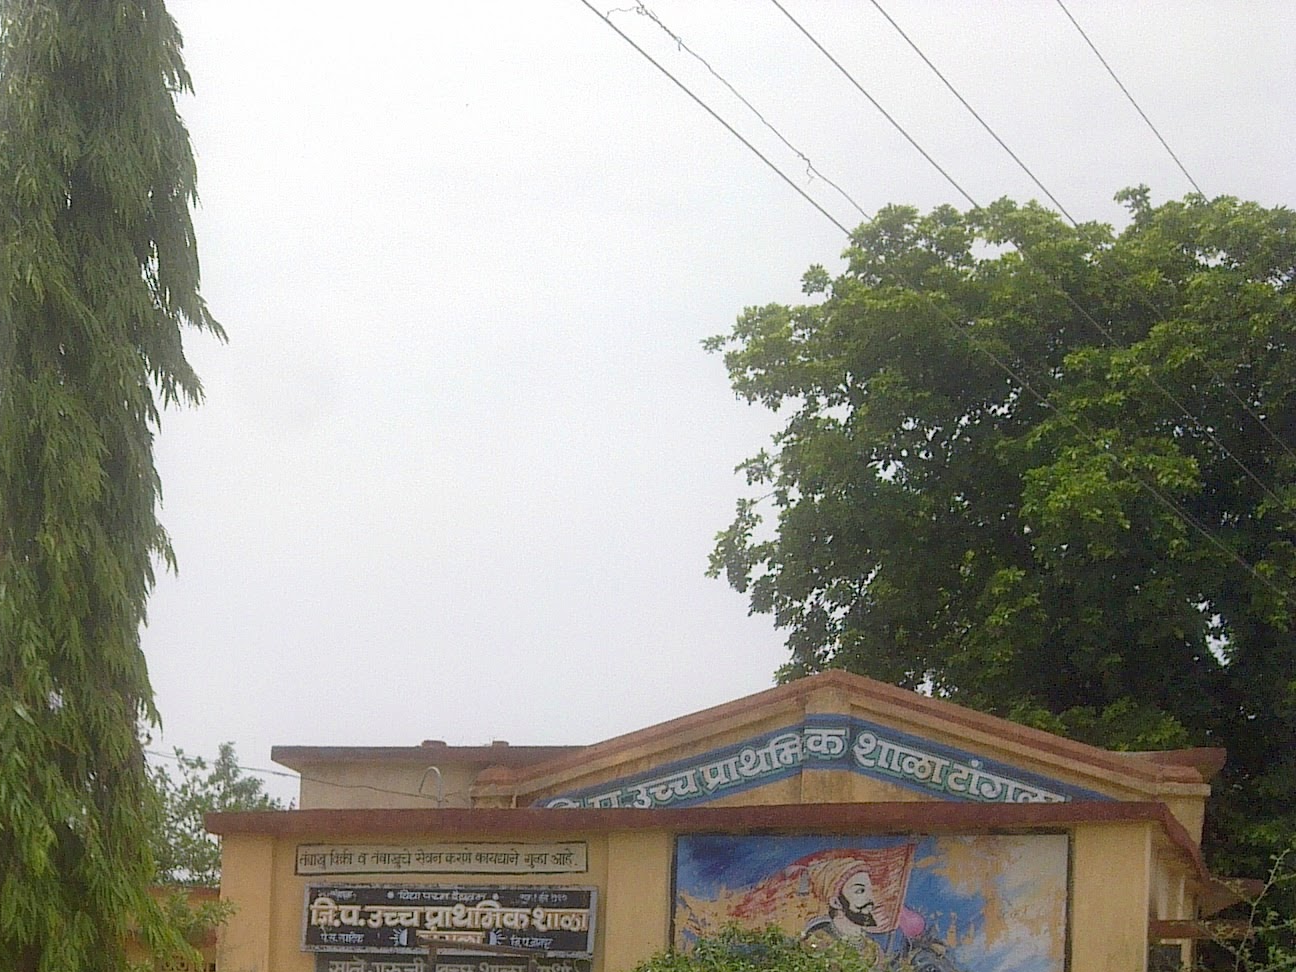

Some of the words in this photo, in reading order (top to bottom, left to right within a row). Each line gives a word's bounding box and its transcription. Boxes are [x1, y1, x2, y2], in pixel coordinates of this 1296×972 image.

[627, 769, 698, 809] उच्च
[700, 728, 847, 792] प्राथमिक
[854, 733, 950, 783] शाळा
[423, 898, 532, 931] प्राथमिक
[532, 904, 590, 933] शाळा
